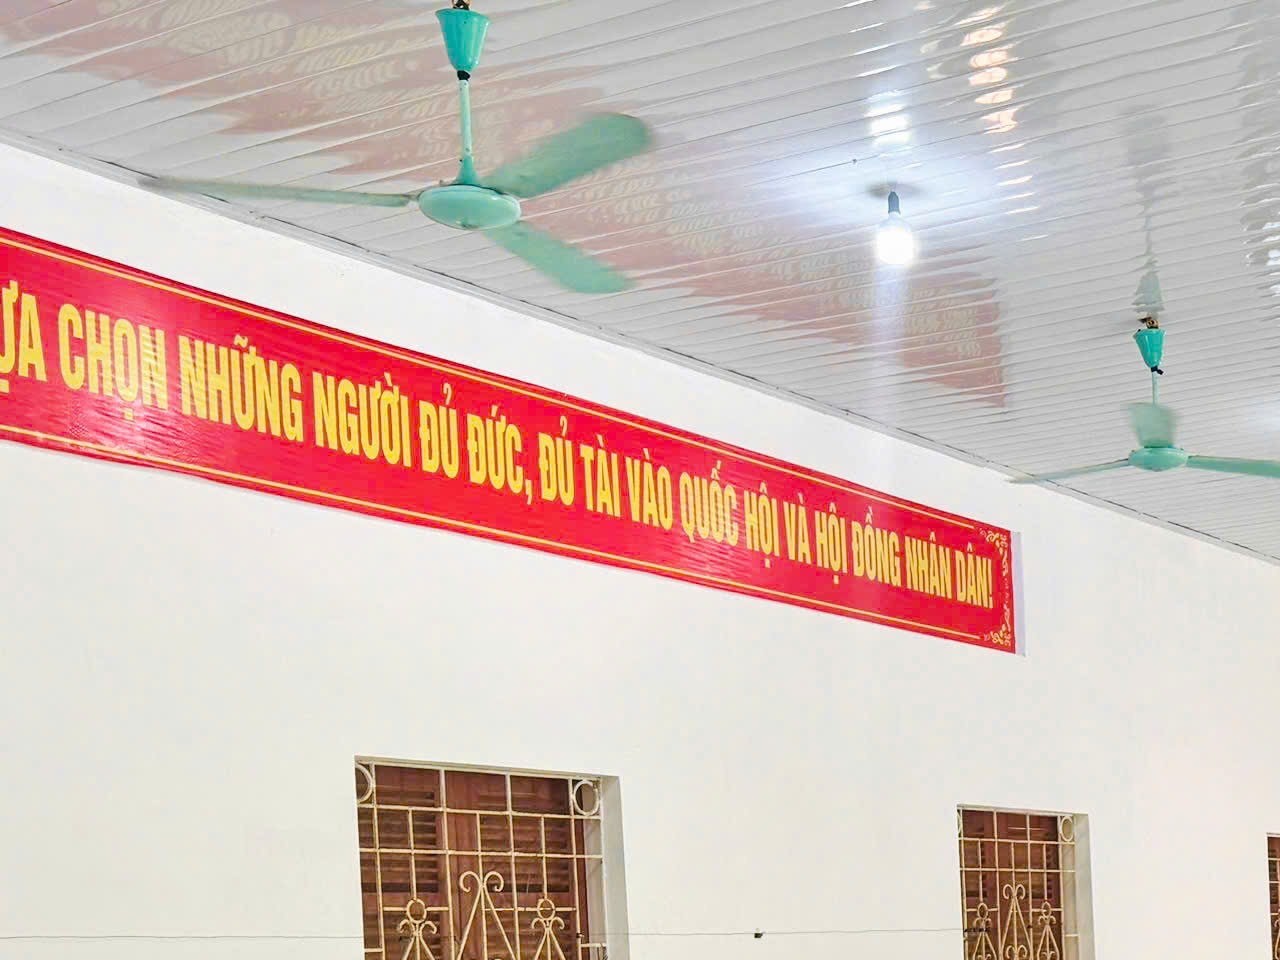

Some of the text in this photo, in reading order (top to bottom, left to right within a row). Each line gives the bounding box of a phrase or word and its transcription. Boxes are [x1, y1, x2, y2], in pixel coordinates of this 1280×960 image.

[58, 303, 169, 421] CHỌN
[178, 335, 304, 442] NHỮNG
[312, 372, 412, 468] NGƯỜI
[419, 383, 460, 479] ĐỦ
[466, 405, 533, 505] ĐỨC,
[538, 415, 576, 506] ĐỦ
[579, 434, 621, 518] TÀI
[625, 448, 674, 531] VÀO
[679, 461, 740, 547] QUỐC
[743, 481, 781, 569] HỘI
[783, 493, 812, 565] VÀ
[815, 504, 849, 584] HỘI
[851, 506, 902, 588] ĐỒNG
[904, 531, 953, 599] NHÂN
[955, 544, 994, 609] DÂN!
